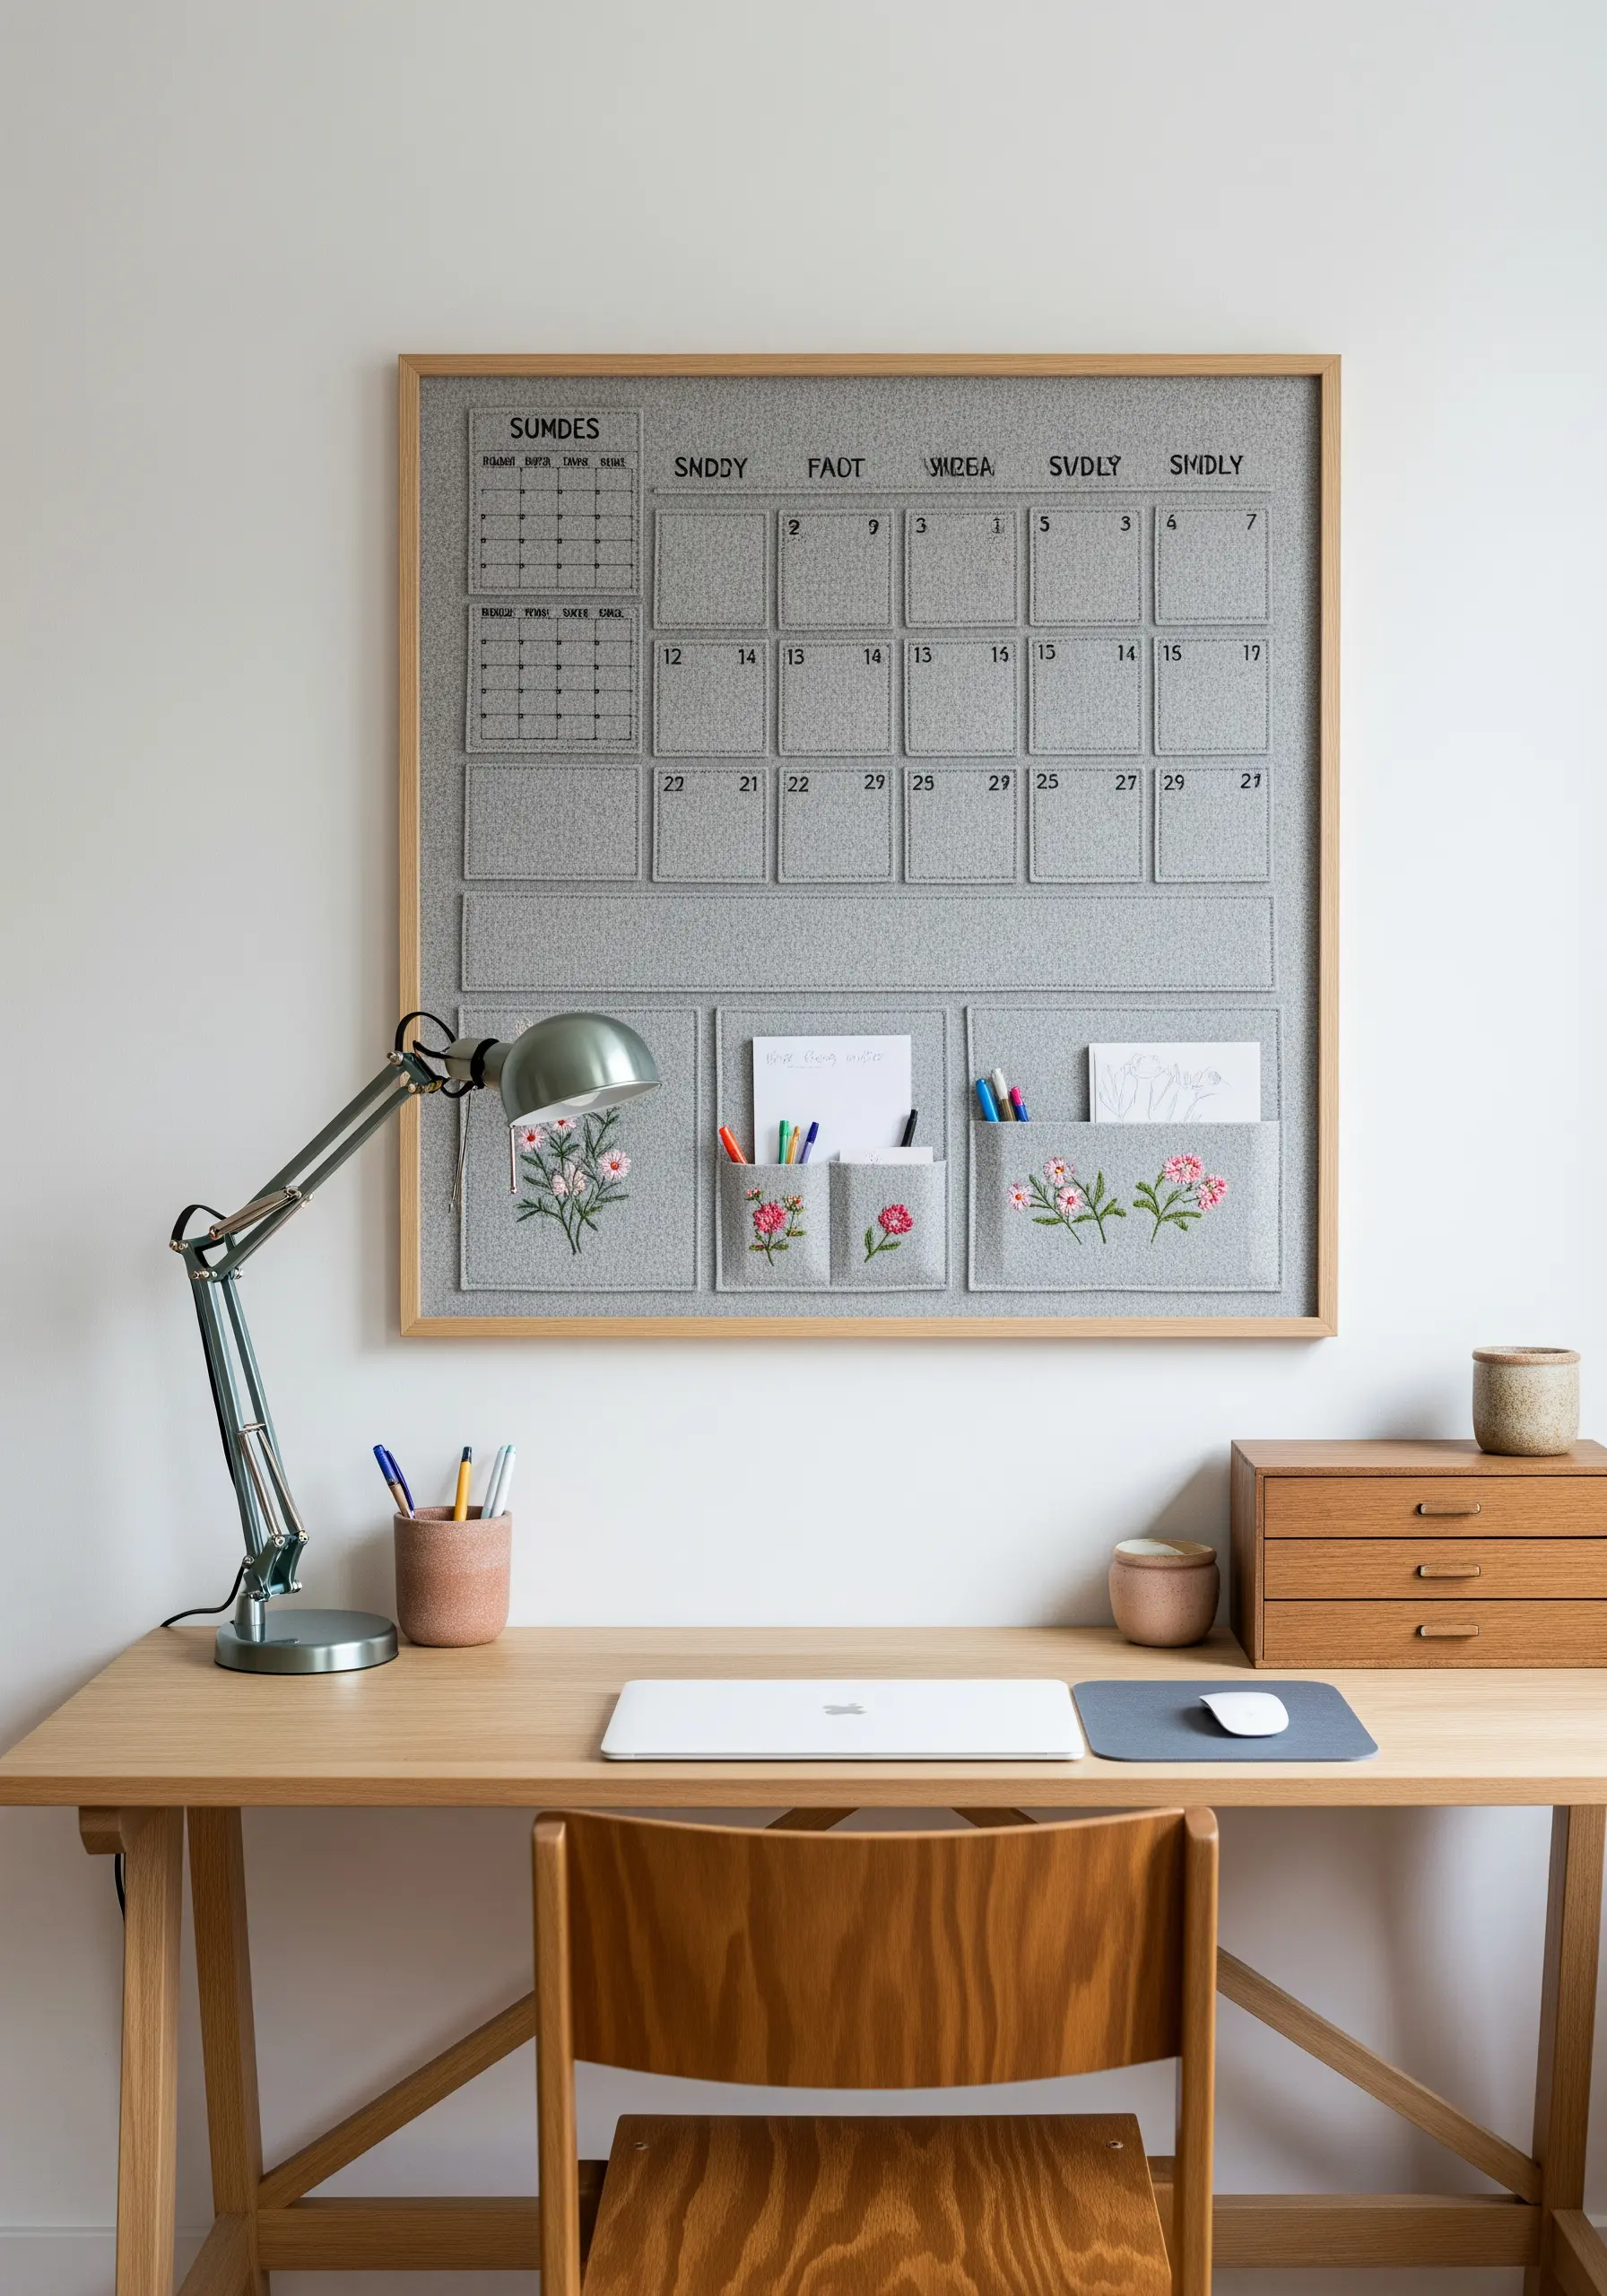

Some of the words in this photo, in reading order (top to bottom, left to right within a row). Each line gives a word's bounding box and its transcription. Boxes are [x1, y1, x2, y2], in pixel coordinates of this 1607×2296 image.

[509, 416, 600, 440] SUMDES
[788, 518, 801, 535] 2
[916, 517, 927, 534] 3
[1039, 516, 1050, 533] 5
[1121, 516, 1131, 532] 3
[1247, 513, 1257, 530] 7
[664, 648, 682, 665] 12
[738, 648, 756, 665] 14
[787, 648, 804, 665] 13
[915, 647, 932, 664] 13
[1118, 644, 1135, 661] 14
[1163, 645, 1182, 661] 15
[739, 776, 757, 792] 21
[787, 776, 809, 793] 22
[864, 774, 885, 790] 29
[1037, 773, 1059, 789] 25
[1116, 774, 1137, 790] 27
[1164, 774, 1185, 791] 29
